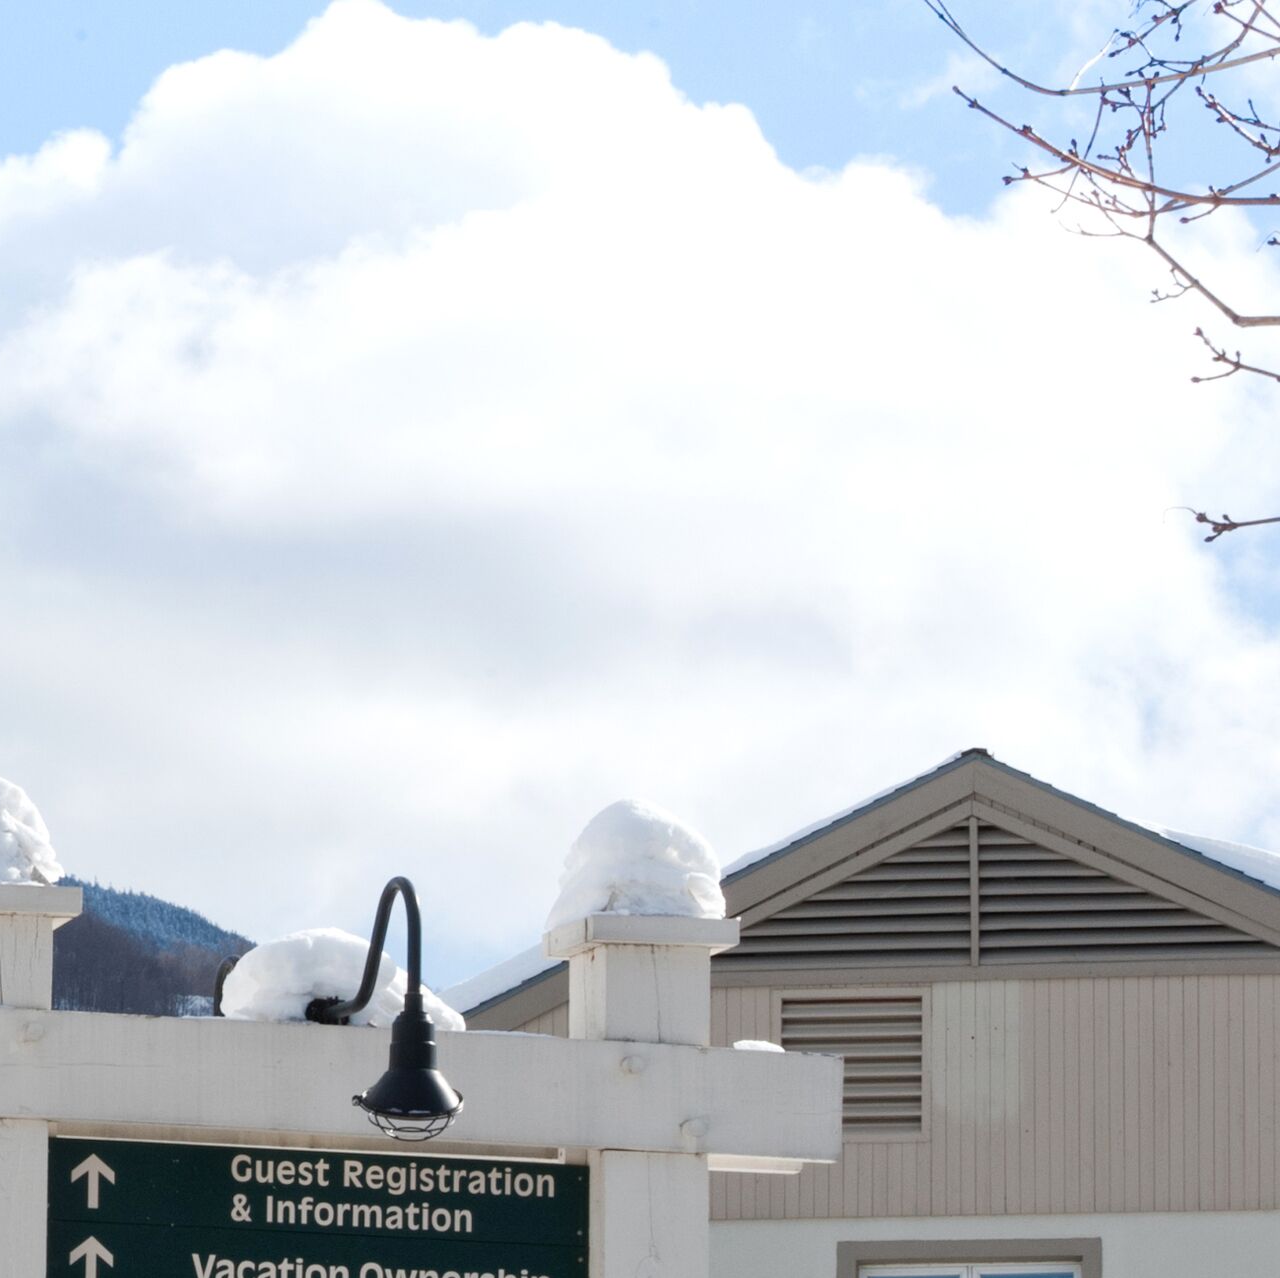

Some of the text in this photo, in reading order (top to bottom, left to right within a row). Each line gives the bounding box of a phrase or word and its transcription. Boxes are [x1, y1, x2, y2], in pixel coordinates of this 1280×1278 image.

[232, 1155, 554, 1197] Guest Registration
[231, 1194, 472, 1232] & Information
